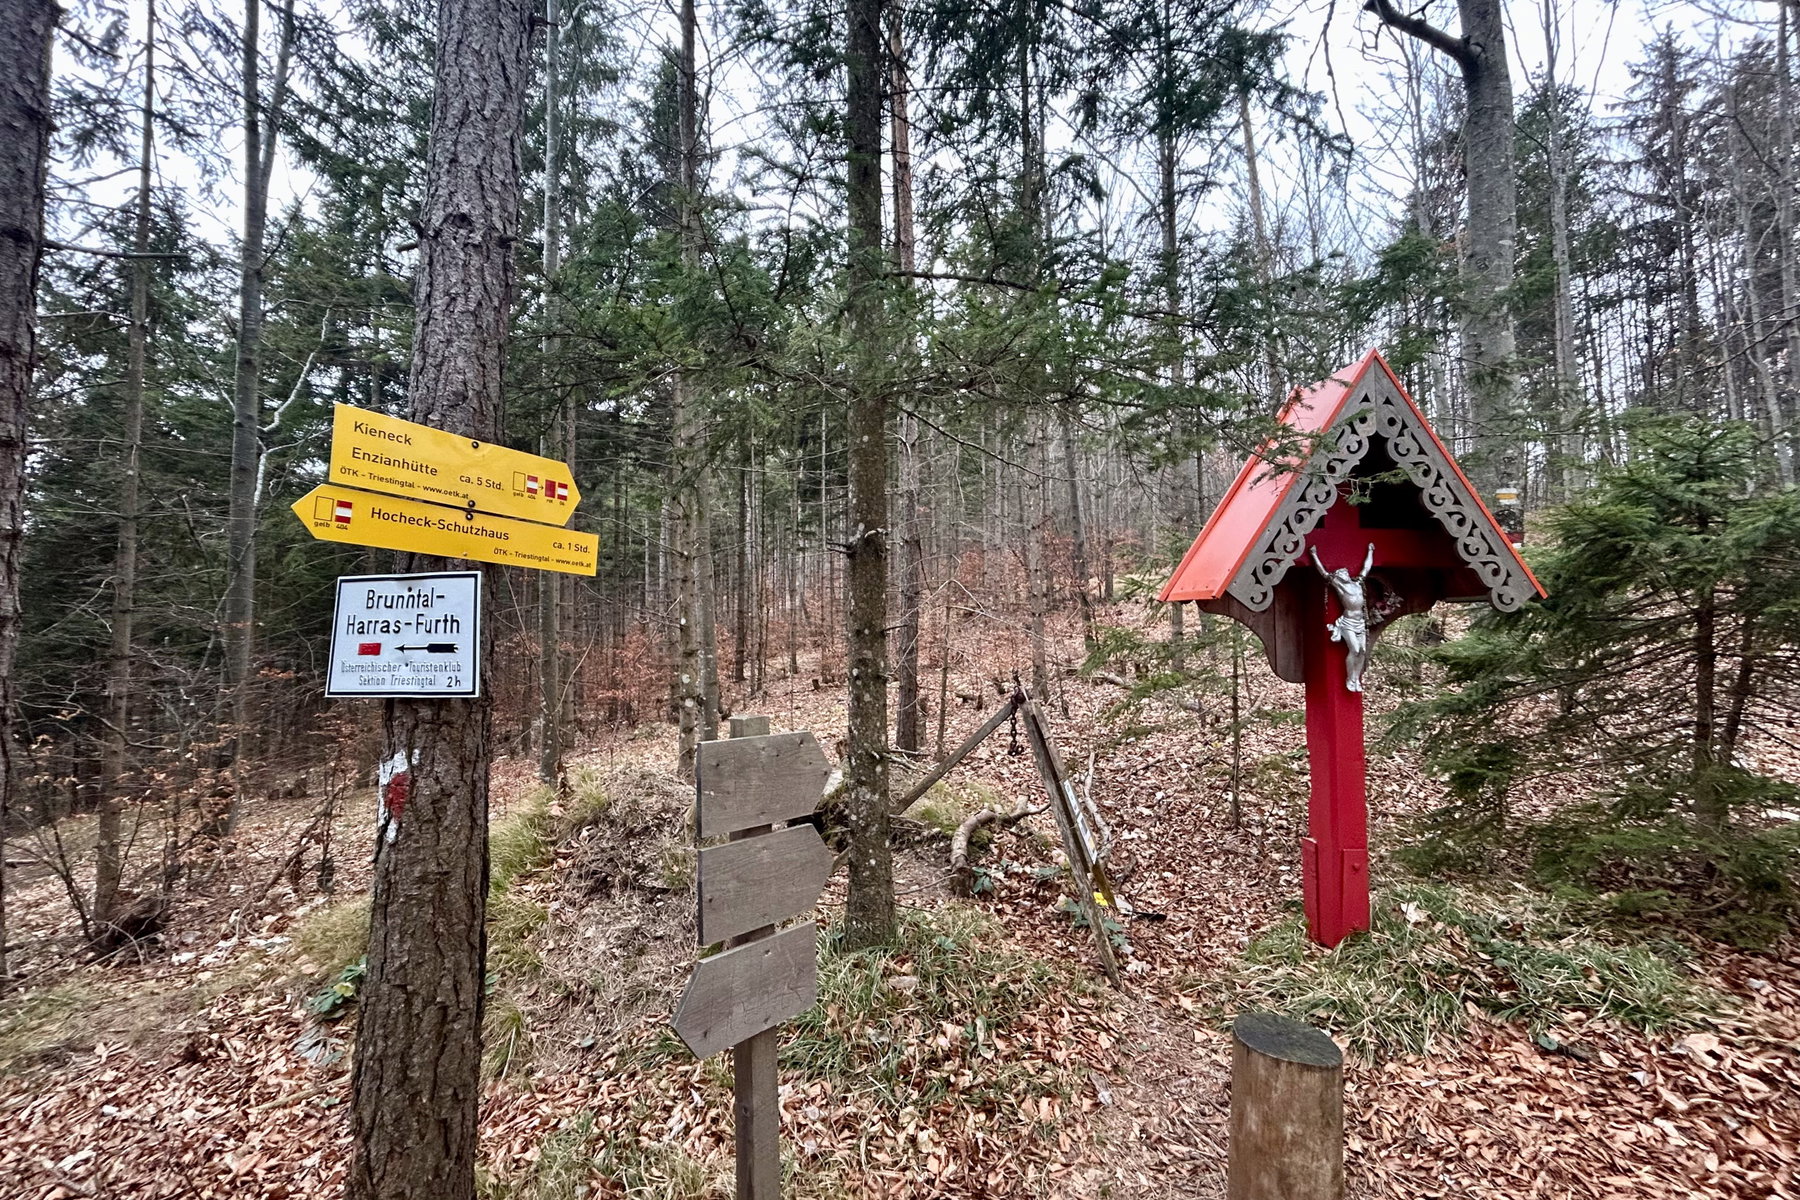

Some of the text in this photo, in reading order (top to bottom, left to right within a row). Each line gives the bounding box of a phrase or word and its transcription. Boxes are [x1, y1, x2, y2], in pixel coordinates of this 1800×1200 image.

[354, 420, 413, 446] Kieneck
[351, 446, 438, 476] Enzianhütte
[340, 466, 359, 477] ÖTK
[368, 472, 415, 489] Triestingtal
[422, 485, 469, 500] www.oetk.at
[459, 474, 504, 491] ca. 5 Std.
[335, 523, 348, 531] 404
[371, 507, 510, 541] Hocheck-Schutzhaus
[493, 546, 508, 556] ÖTK
[515, 551, 550, 562] Triestingtal
[555, 558, 591, 568] www.oetk.at
[552, 541, 590, 554] ca. 1 Std.
[366, 587, 445, 609] Brunntal-
[346, 613, 460, 635] Harras-Furth
[341, 660, 461, 673] Österreichischer Touristenklub
[358, 674, 386, 686] Sektion
[390, 674, 436, 688] Triestingtal
